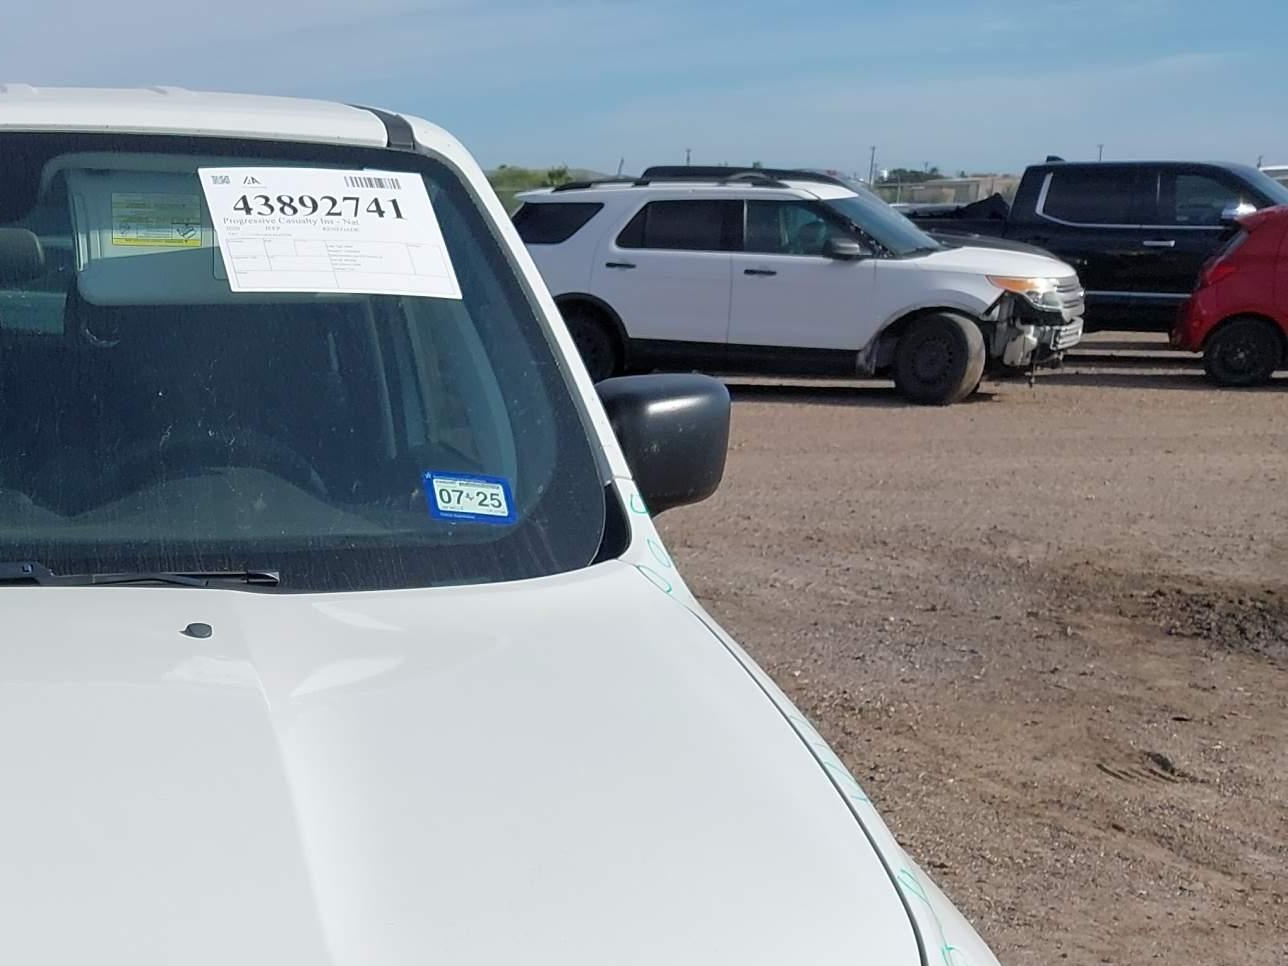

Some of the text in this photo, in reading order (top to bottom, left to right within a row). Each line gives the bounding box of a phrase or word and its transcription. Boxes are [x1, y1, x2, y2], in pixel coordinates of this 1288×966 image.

[233, 194, 405, 220] 43892741
[279, 217, 316, 226] Casualty
[438, 488, 502, 508] 07 25
